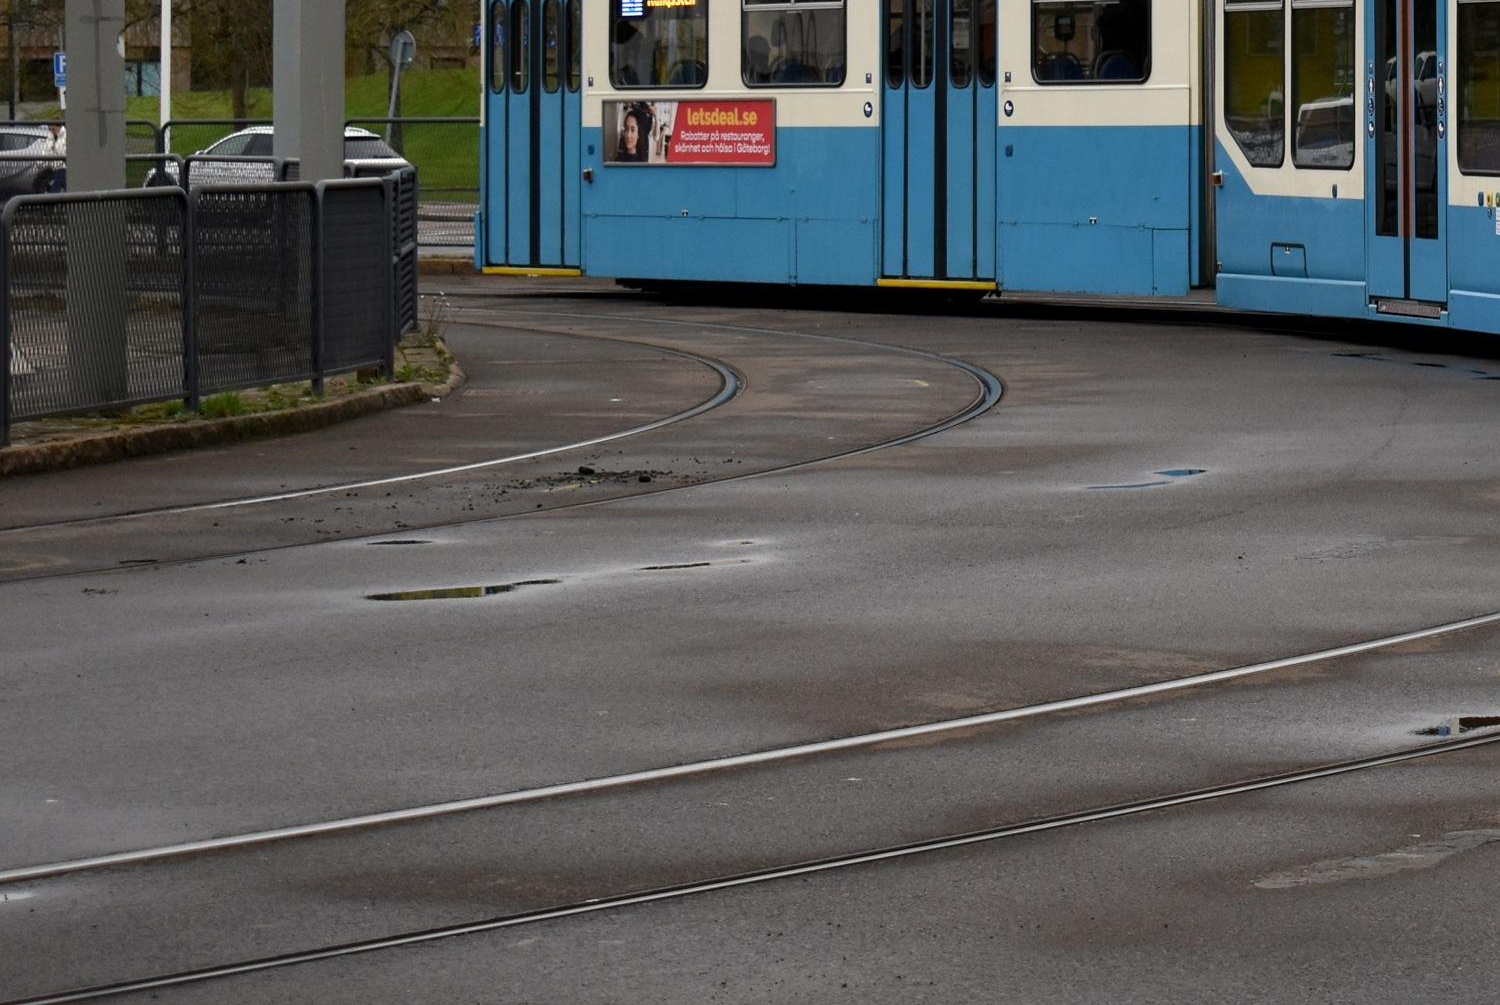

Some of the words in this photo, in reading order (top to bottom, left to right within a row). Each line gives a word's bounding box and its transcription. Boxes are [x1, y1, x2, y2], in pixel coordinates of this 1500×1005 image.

[687, 108, 757, 126] letsdeal.se
[680, 130, 710, 140] Rabatter
[710, 131, 720, 142] på
[675, 143, 700, 153] skönhet
[701, 143, 714, 153] och
[715, 143, 733, 153] hälsa
[737, 143, 771, 156] Göteborg!
